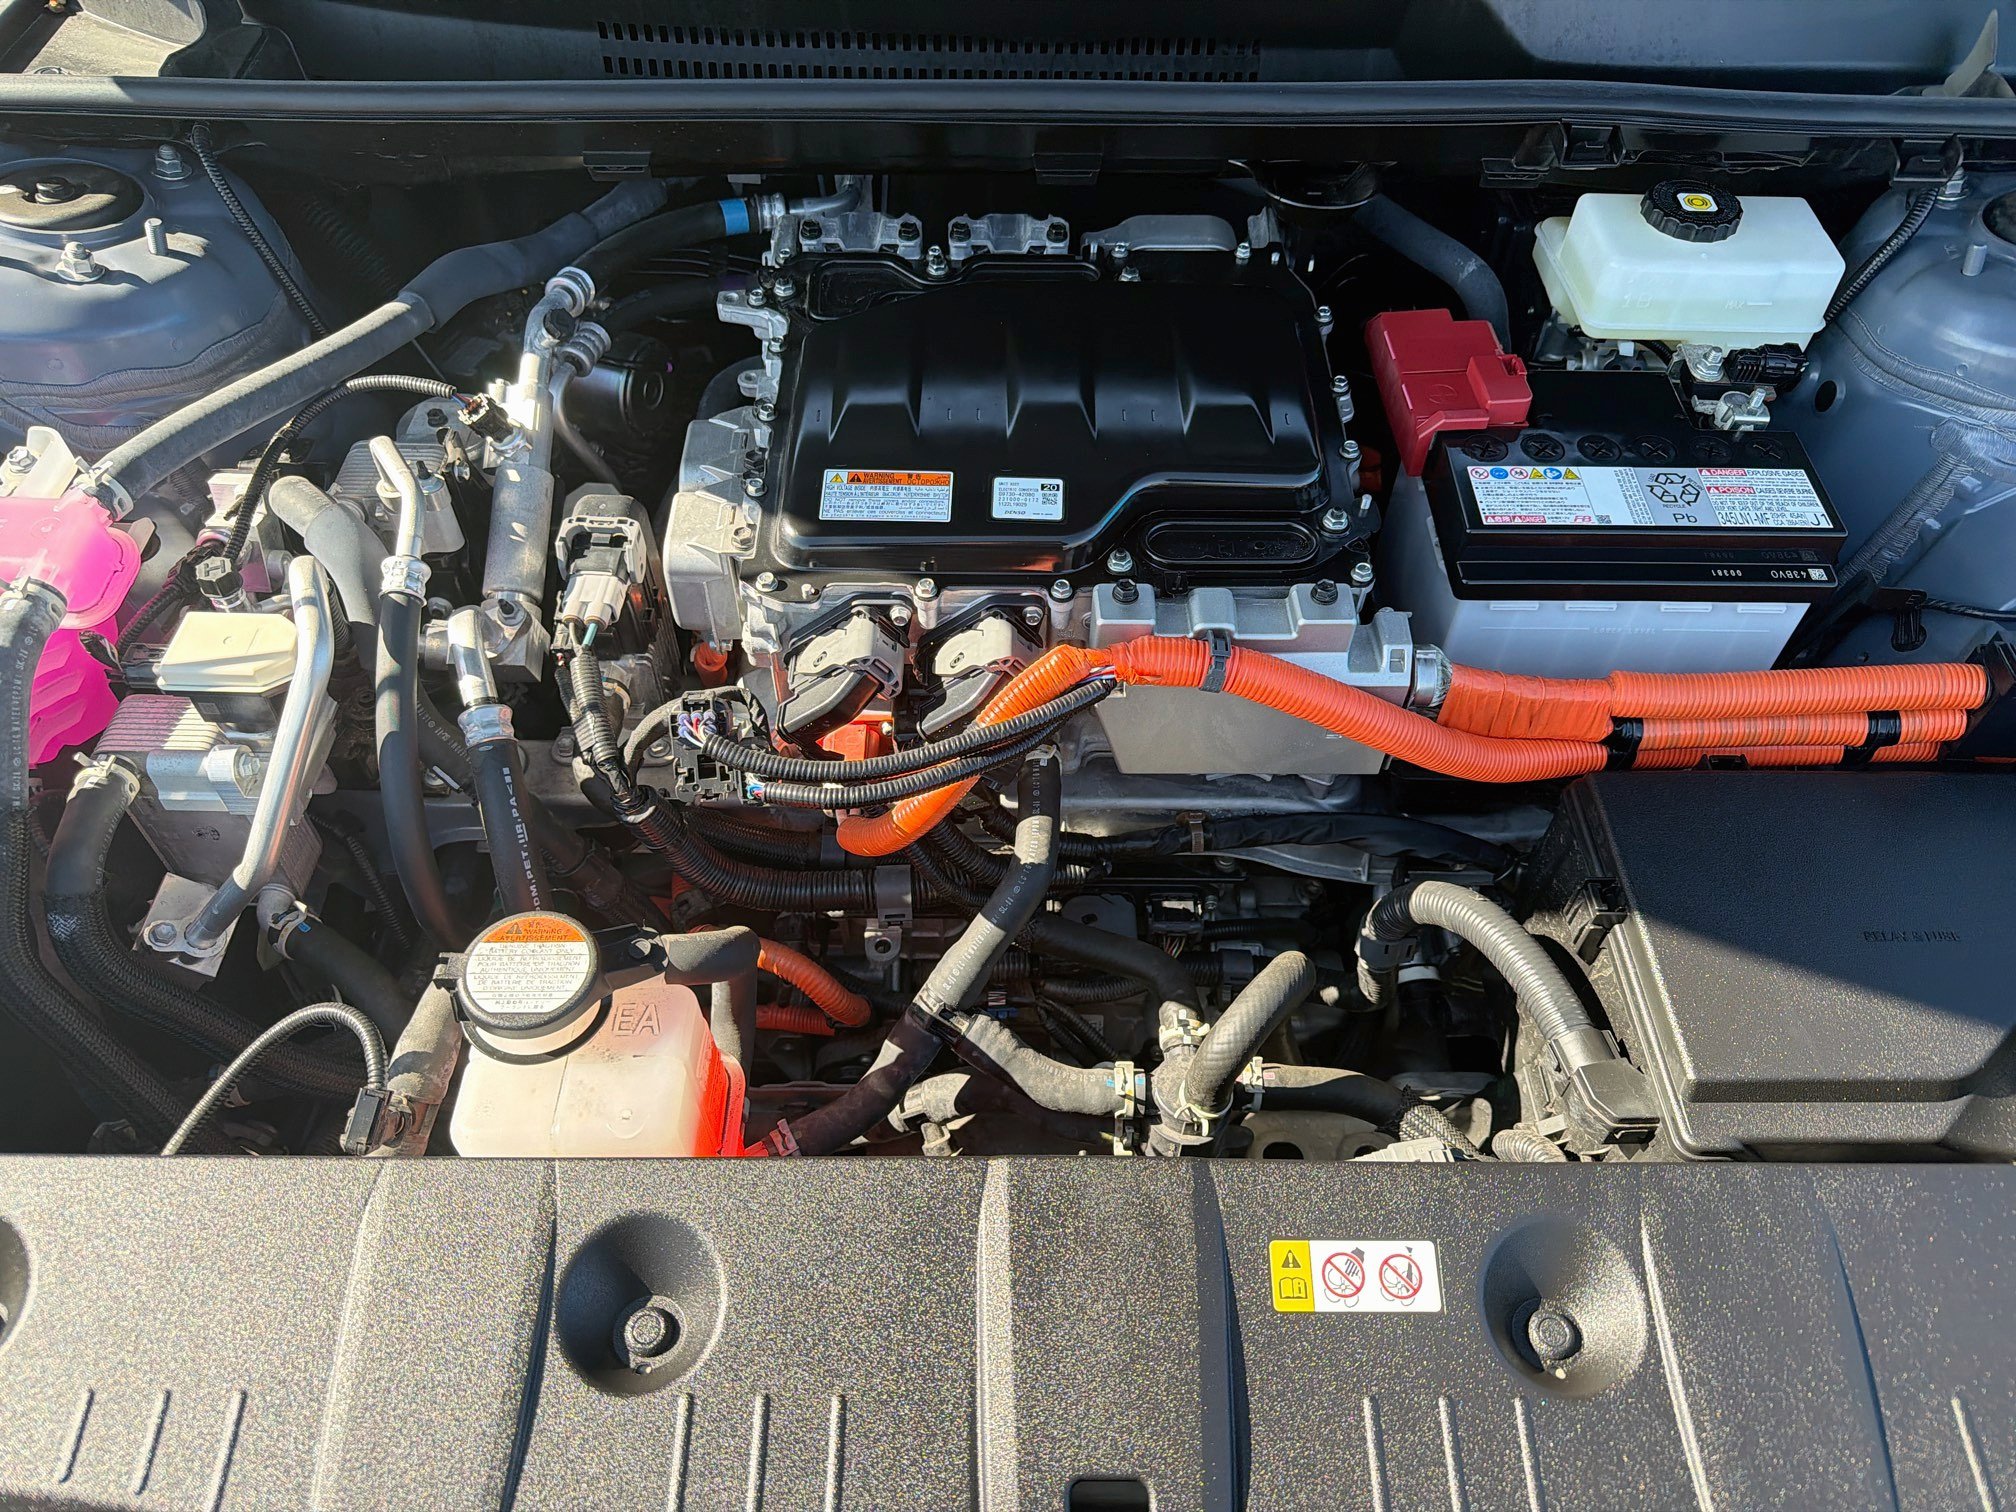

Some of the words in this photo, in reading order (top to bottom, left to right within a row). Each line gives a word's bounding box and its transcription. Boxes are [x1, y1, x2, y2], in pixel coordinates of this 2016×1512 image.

[1673, 513, 1697, 523] Pb
[1718, 512, 1770, 525] 345LN1-MF
[1811, 513, 1830, 526] J1
[612, 1003, 661, 1037] EA
